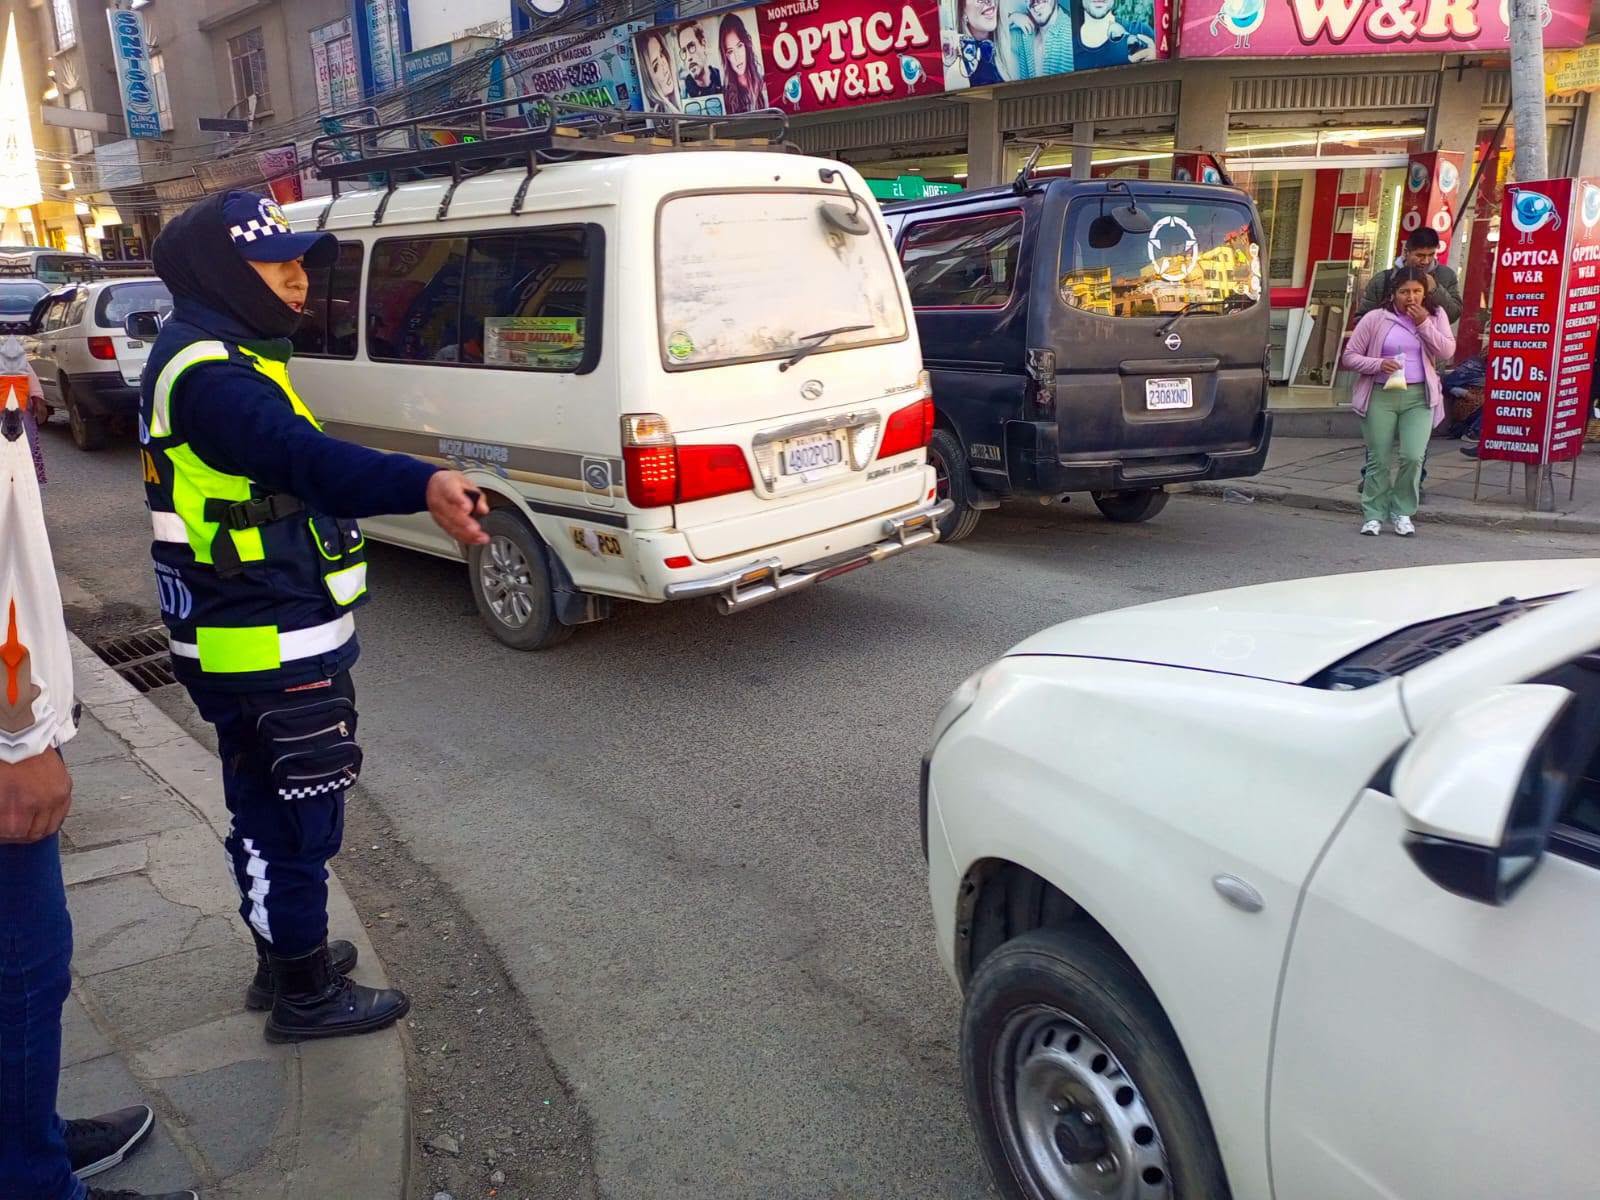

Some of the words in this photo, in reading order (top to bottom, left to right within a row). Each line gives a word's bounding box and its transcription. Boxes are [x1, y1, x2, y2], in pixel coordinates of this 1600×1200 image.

[767, 0, 820, 21] MONTURAS
[1289, 0, 1482, 44] W&R
[773, 4, 930, 71] ÓPTICA
[116, 13, 150, 103] SONRISAS
[808, 60, 894, 103] W&R
[892, 183, 904, 196] EL
[1501, 247, 1559, 266] ÓPTICA
[1513, 270, 1543, 283] W&R
[1578, 265, 1596, 279] W&R
[1505, 306, 1539, 317] LENTE
[1494, 323, 1550, 334] COMPLETO
[1565, 315, 1598, 328] GENERACION
[1493, 340, 1512, 348] BLUE
[1513, 341, 1548, 349] BLOCKER
[1491, 356, 1523, 382] 150
[1529, 366, 1547, 381] Bs.
[1149, 388, 1188, 405] 2308XND
[1491, 389, 1541, 402] MEDICION
[1496, 406, 1533, 418] GRATIS
[1496, 425, 1523, 436] MANUAL
[1525, 427, 1531, 436] Y
[1485, 439, 1539, 453] COMPUTARIZADA
